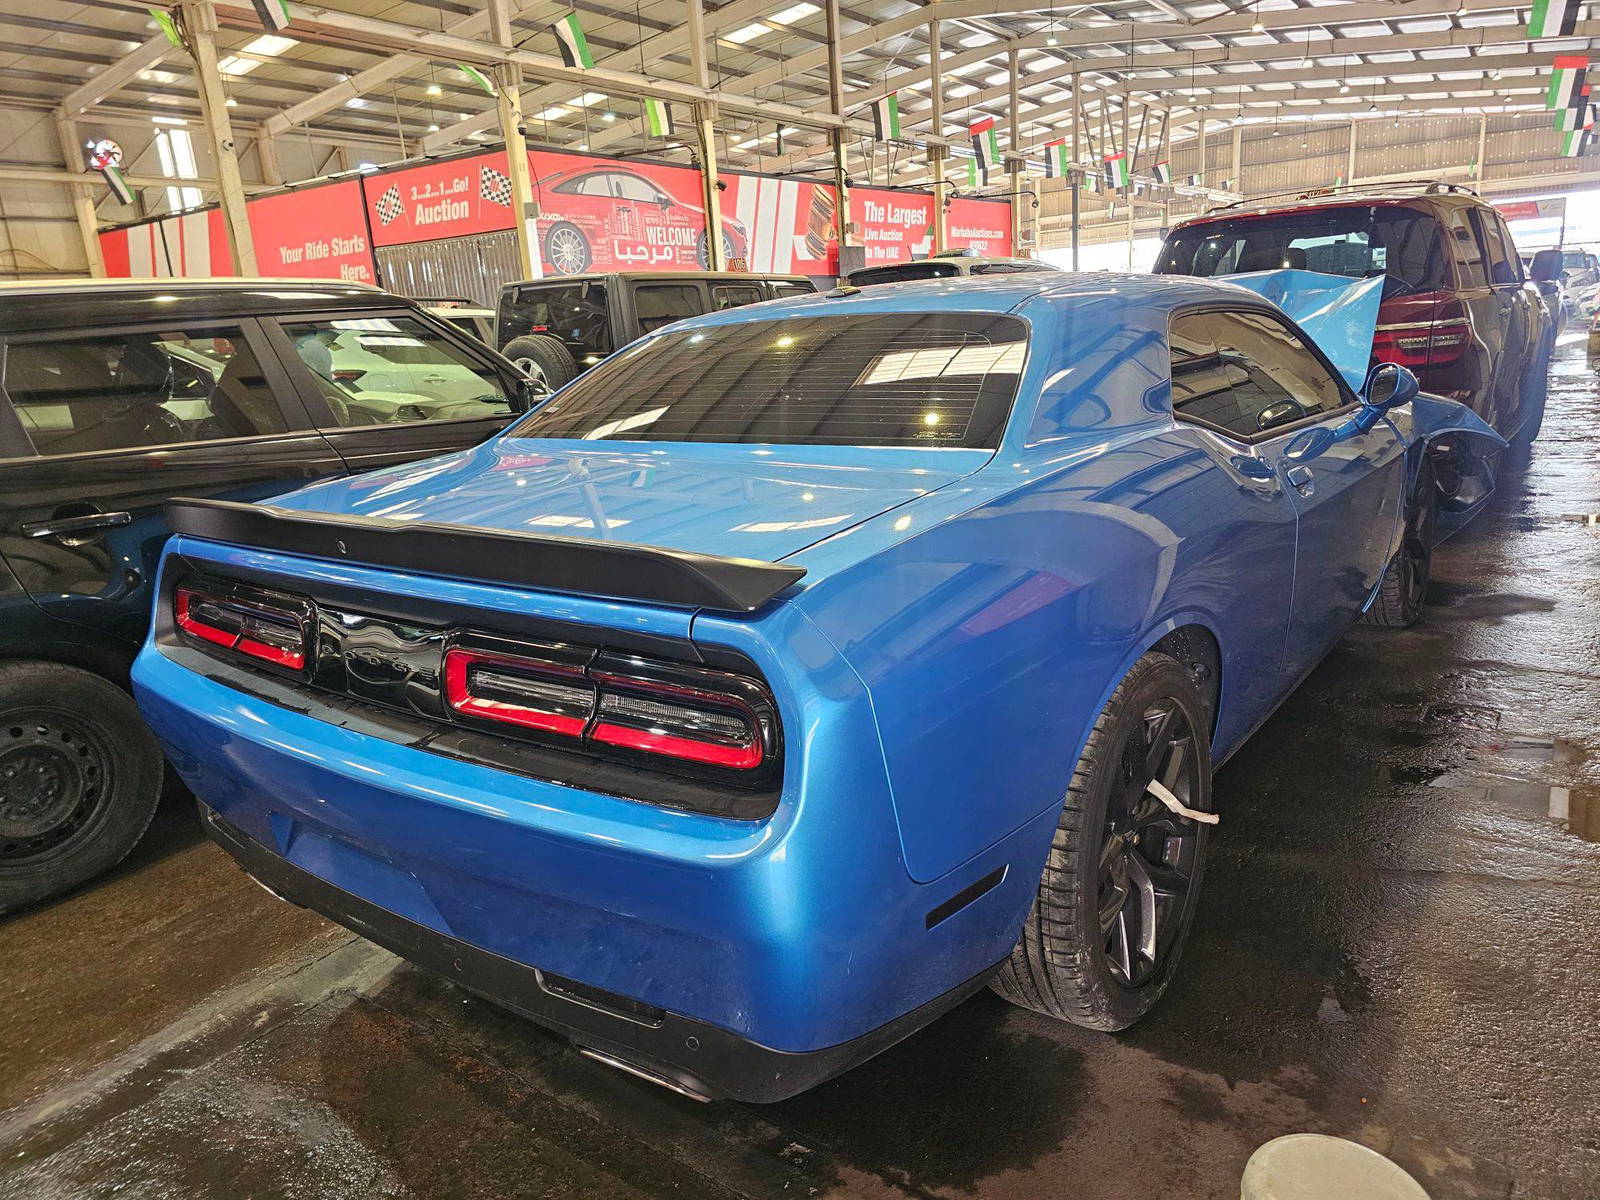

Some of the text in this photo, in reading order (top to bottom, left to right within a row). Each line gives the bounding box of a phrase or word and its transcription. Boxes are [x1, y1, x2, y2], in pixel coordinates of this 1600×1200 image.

[415, 199, 470, 225] Auction
[864, 200, 927, 229] The Largest
[646, 226, 697, 246] WELCOME
[864, 228, 903, 242] Live Auction
[279, 234, 365, 264] Your Ride Starts
[613, 239, 673, 264] مرحبا
[865, 246, 900, 259] In The UAE
[340, 263, 370, 281] Here.
